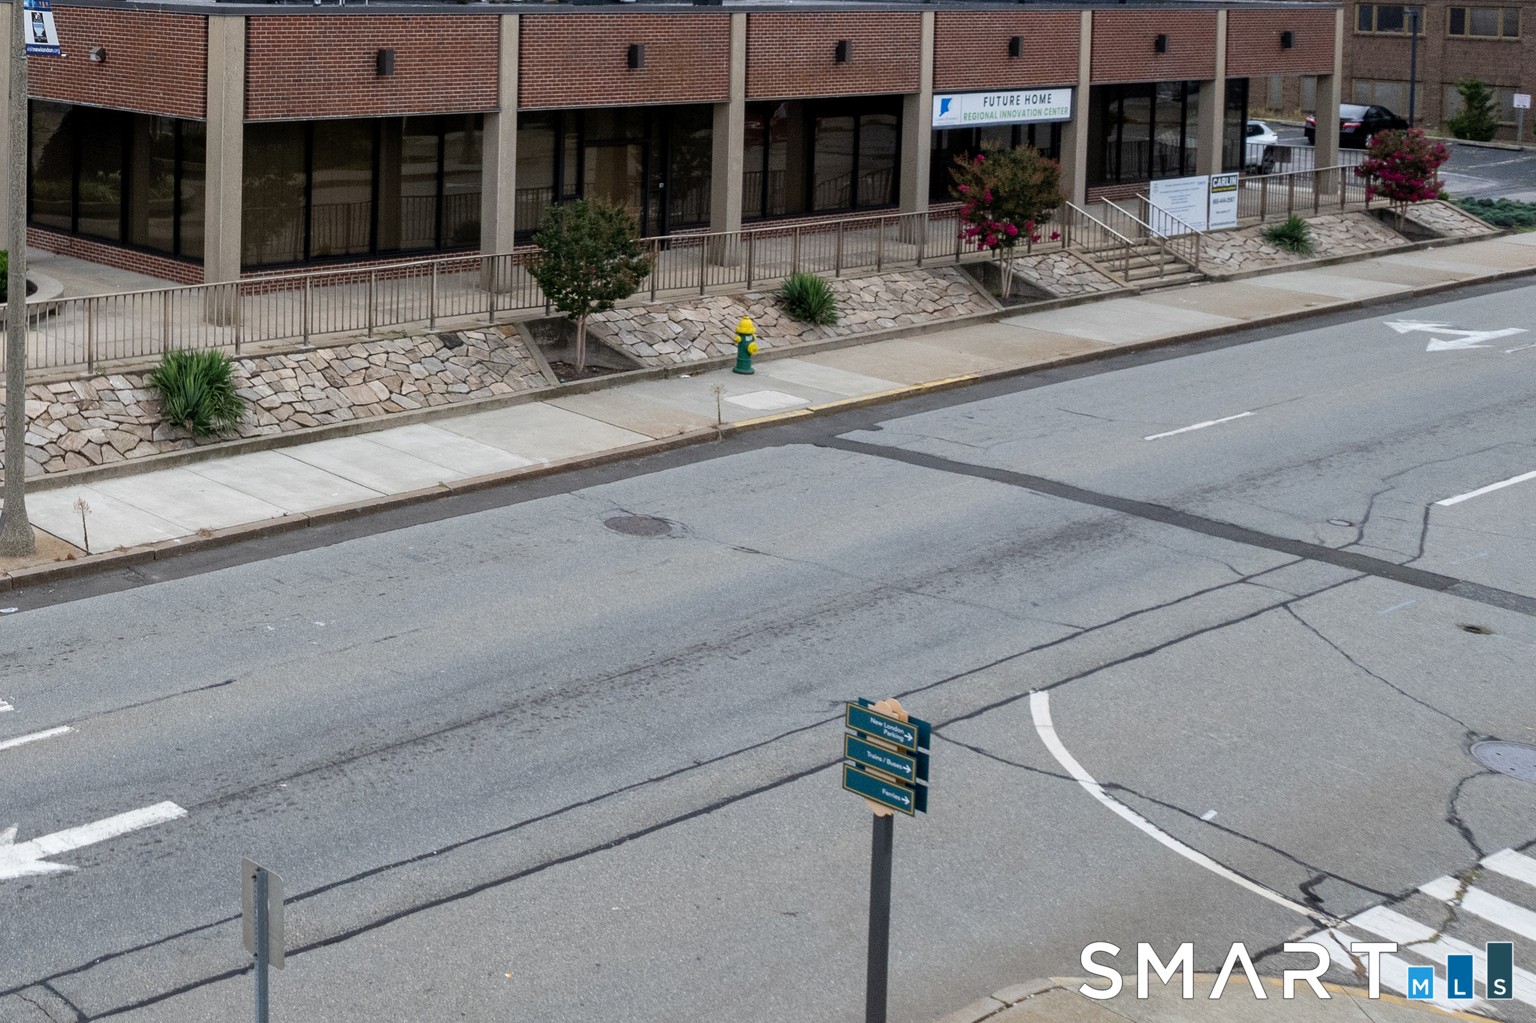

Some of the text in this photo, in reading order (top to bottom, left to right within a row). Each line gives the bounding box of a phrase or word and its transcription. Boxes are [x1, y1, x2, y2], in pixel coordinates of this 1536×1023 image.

[983, 93, 1052, 107] FUTURE HOME
[964, 110, 998, 121] REGIONAL
[999, 107, 1043, 119] INNOVATION
[1044, 106, 1069, 116] CENTER
[1212, 176, 1237, 188] CARLIN
[870, 717, 904, 734] New London
[883, 728, 904, 743] Parking
[867, 750, 883, 763] Trains
[886, 758, 903, 770] Buses
[882, 788, 901, 801] Ferries
